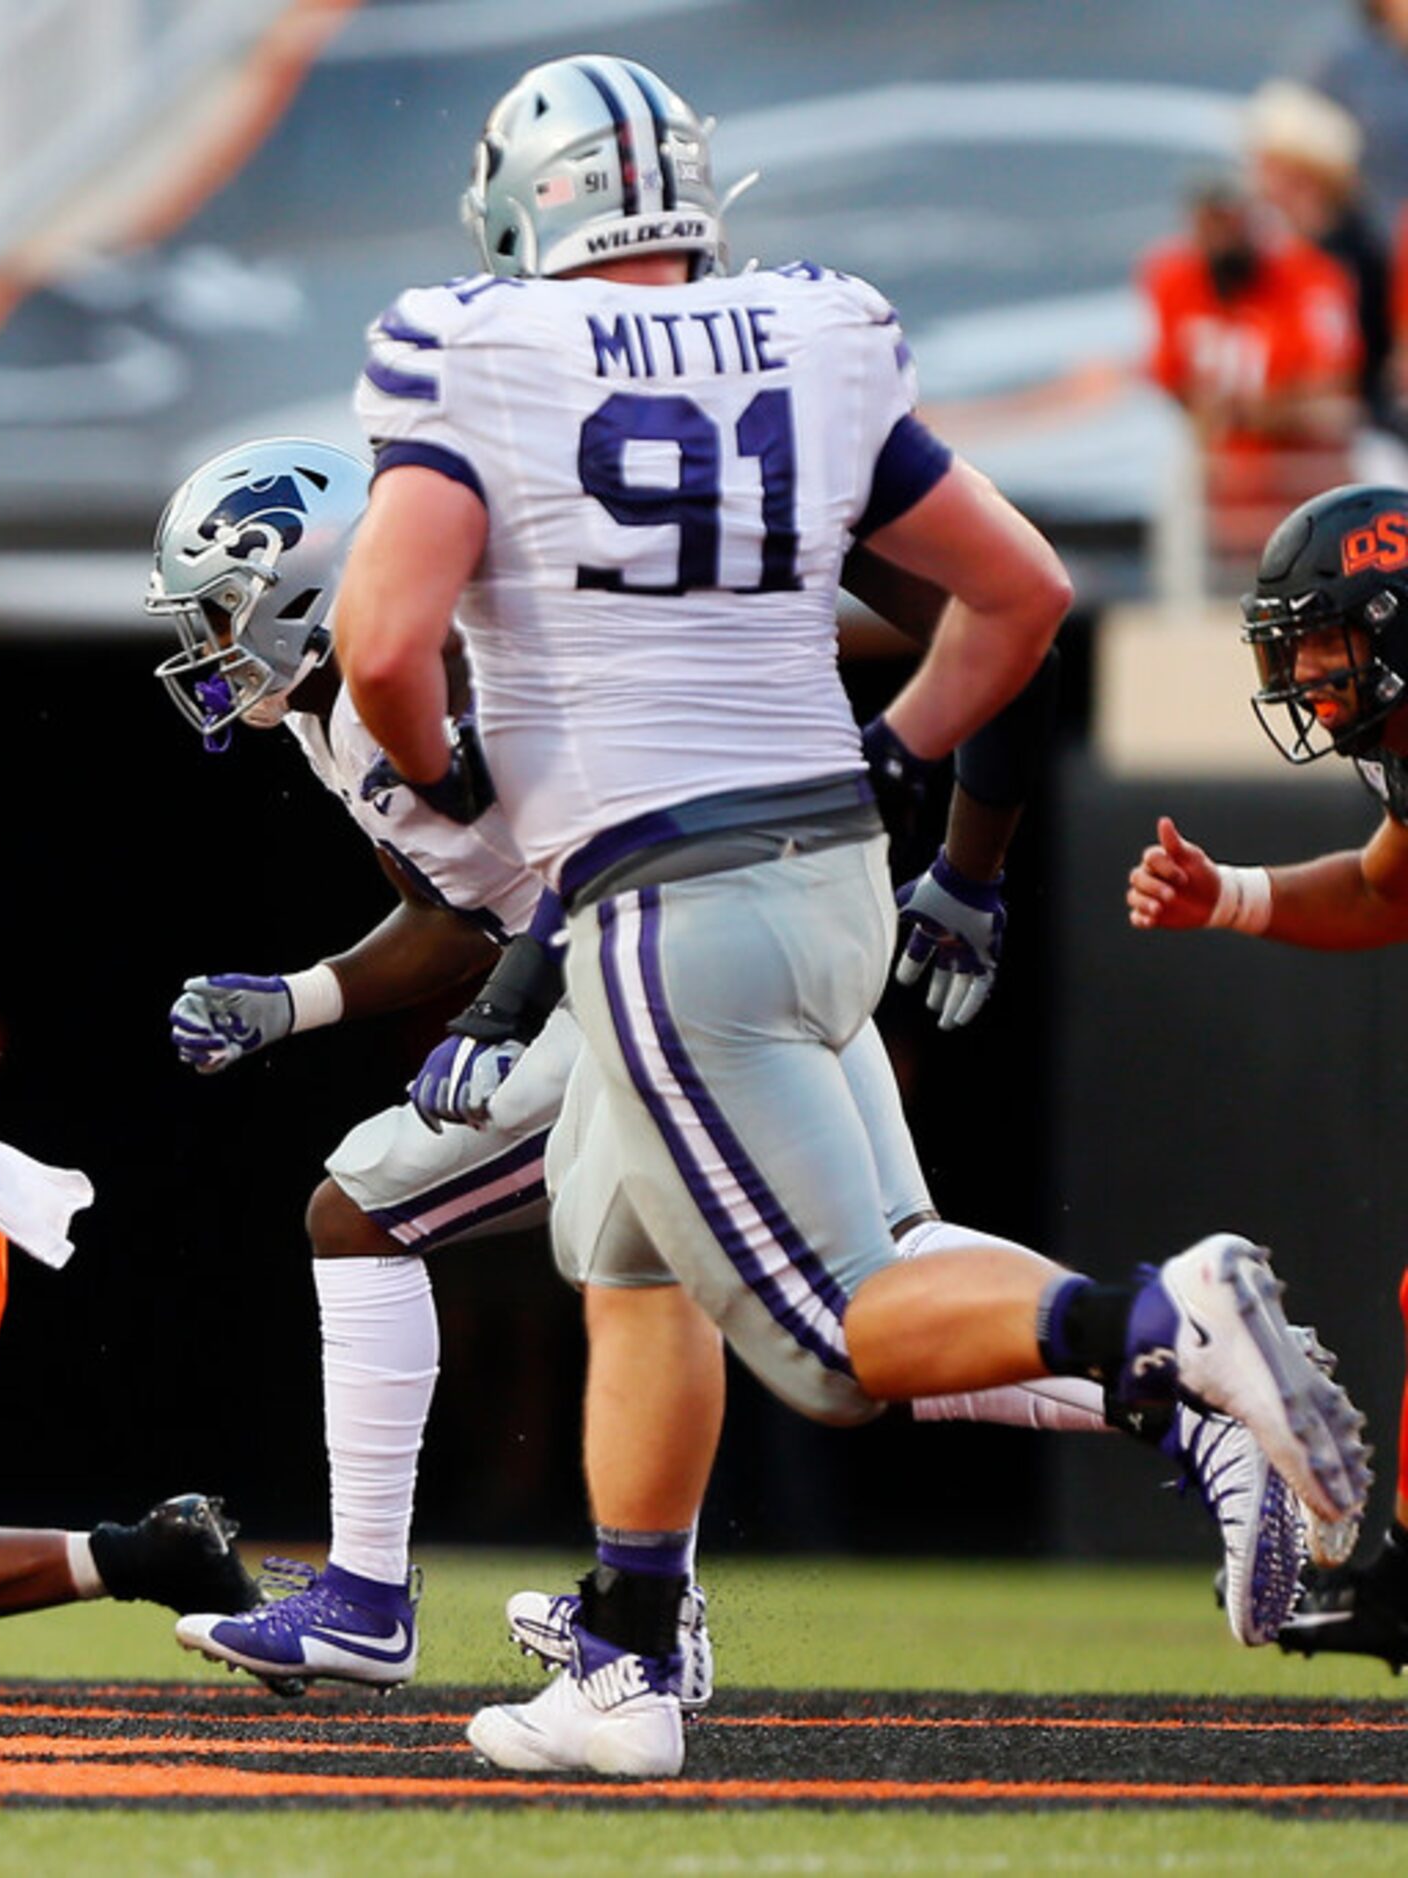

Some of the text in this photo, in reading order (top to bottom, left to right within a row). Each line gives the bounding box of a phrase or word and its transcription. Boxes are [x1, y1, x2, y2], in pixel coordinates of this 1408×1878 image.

[585, 171, 609, 193] 91
[587, 219, 705, 254] WILDCATS
[587, 308, 787, 377] MITTIE
[577, 388, 804, 595] 91
[1342, 510, 1408, 577] OS
[581, 1653, 651, 1707] NIKE
